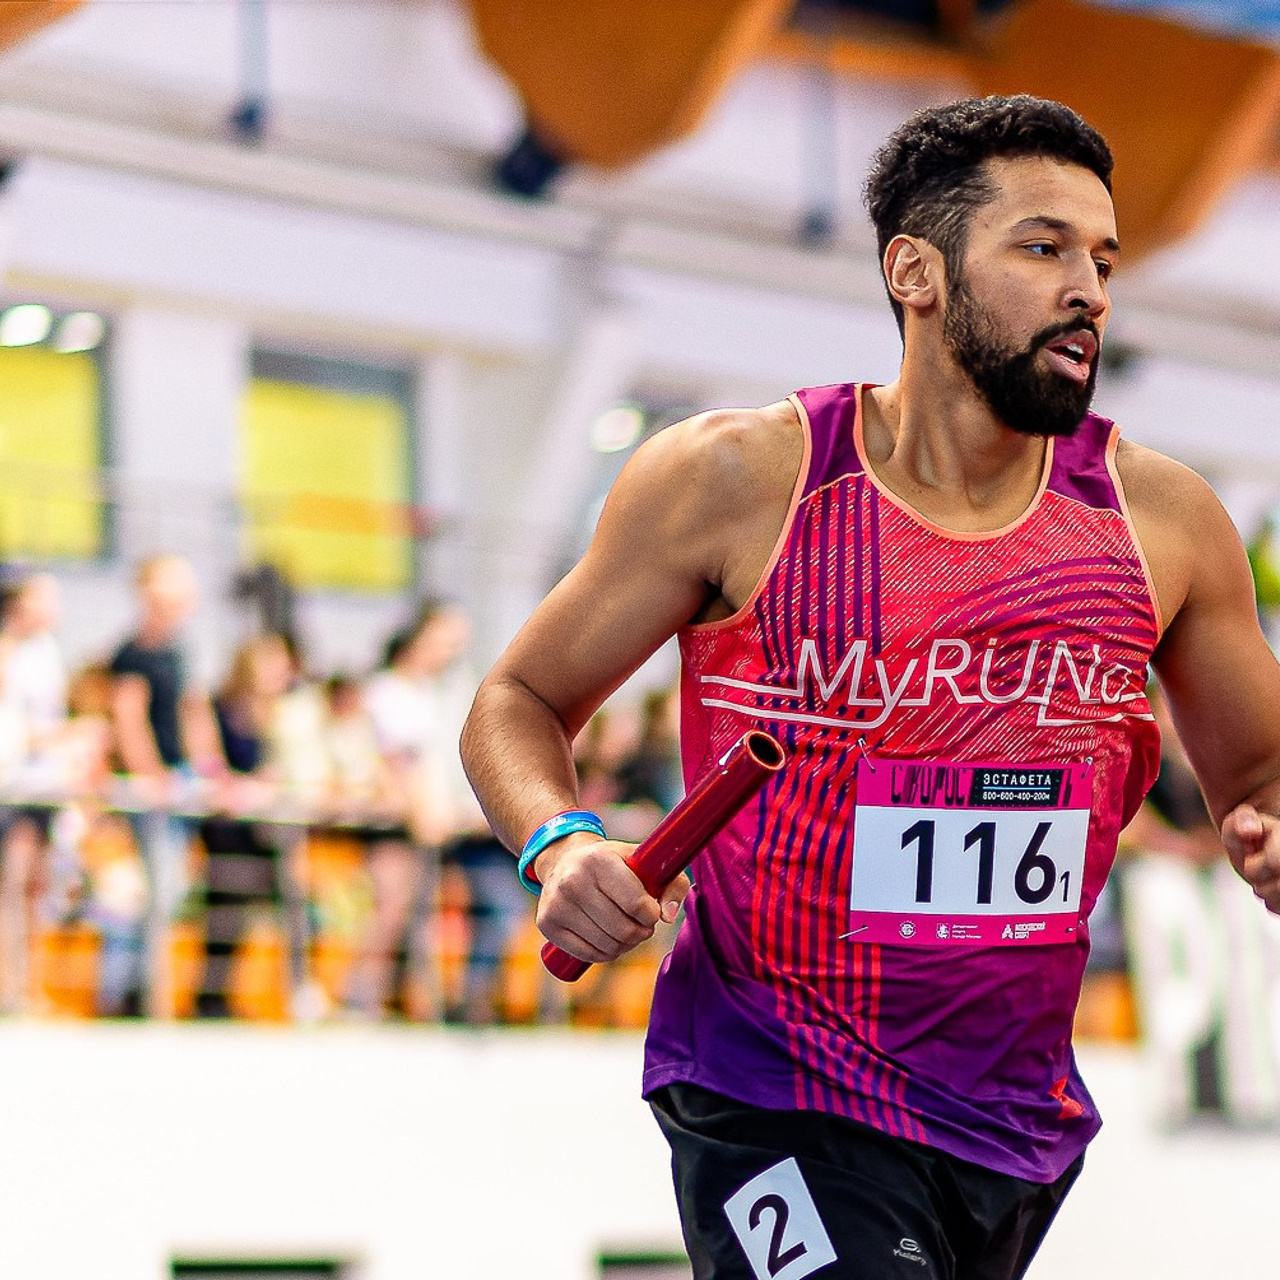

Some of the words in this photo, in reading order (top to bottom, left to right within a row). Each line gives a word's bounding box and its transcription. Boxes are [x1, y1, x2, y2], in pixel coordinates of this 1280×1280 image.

[983, 773, 1052, 786] ЭСТАФЕТА
[901, 819, 1057, 905] 116
[749, 1194, 808, 1279] 2
